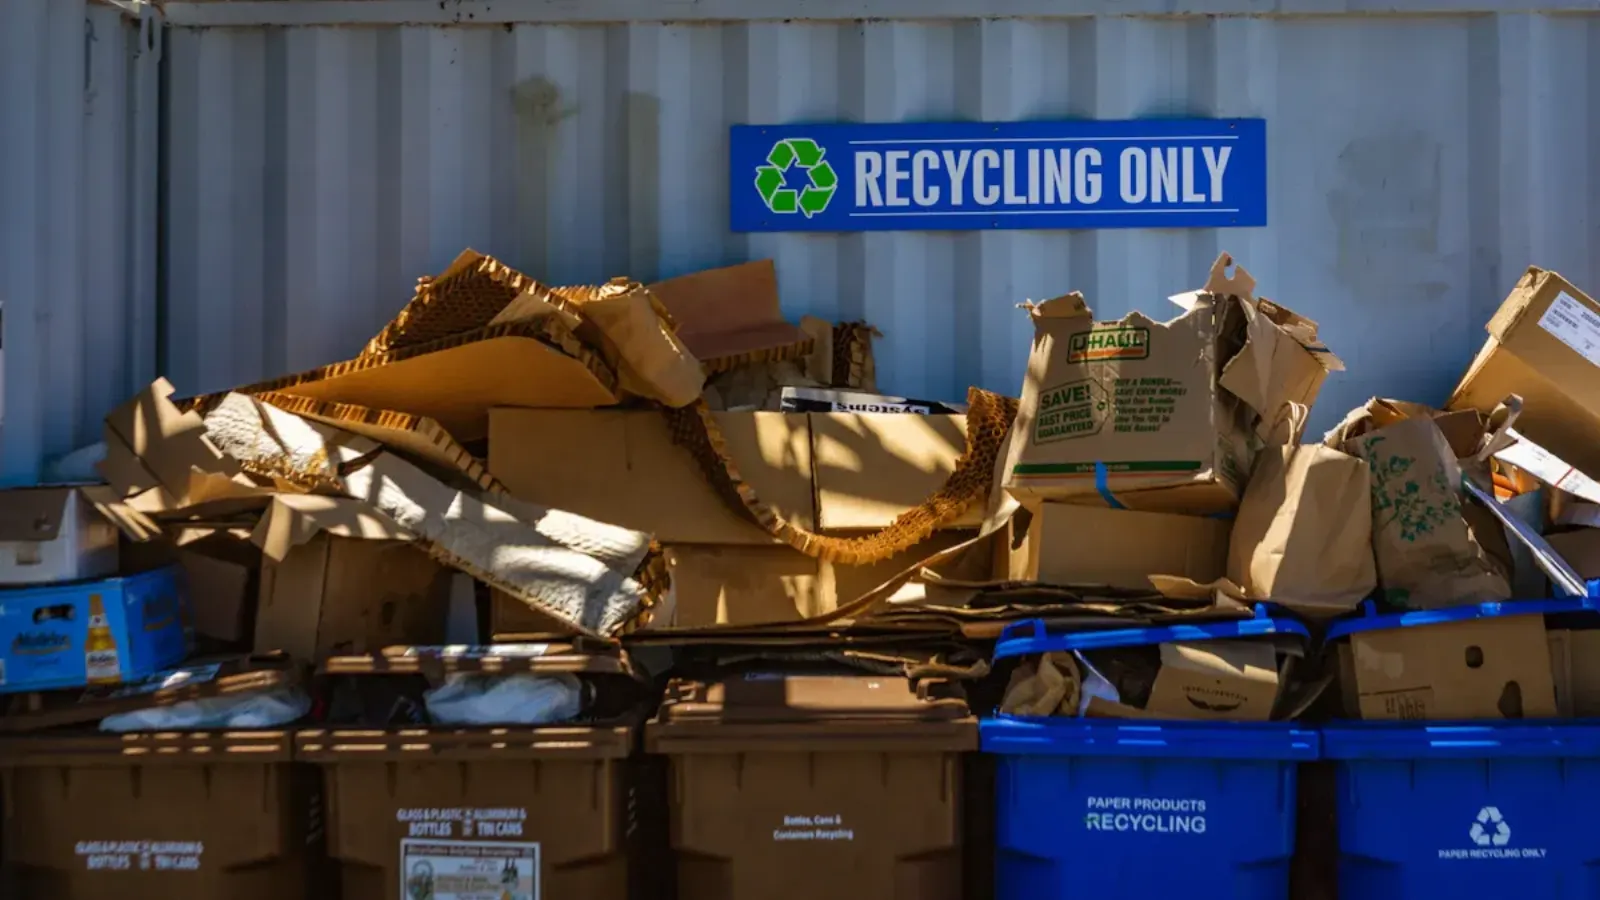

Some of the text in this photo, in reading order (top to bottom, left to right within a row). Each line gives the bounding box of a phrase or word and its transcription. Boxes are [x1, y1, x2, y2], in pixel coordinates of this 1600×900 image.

[855, 146, 1233, 206] RECYCLING ONLY
[1073, 333, 1144, 351] U-HAUL
[1040, 384, 1092, 410] SAVE!
[1115, 387, 1134, 396] SAVE
[1038, 408, 1092, 427] BEST PRICE
[1037, 420, 1094, 440] GUARANTEED
[1087, 796, 1207, 812] PAPER PRODUCTS
[396, 808, 424, 821] GLASS
[431, 808, 463, 821] PLASTIC
[1086, 813, 1207, 833] RECYCLING
[409, 822, 452, 837] BOTTLES
[477, 822, 495, 837] TIN
[496, 822, 523, 837] CANS
[1438, 848, 1547, 859] PAPER RECYCLING ONLY
